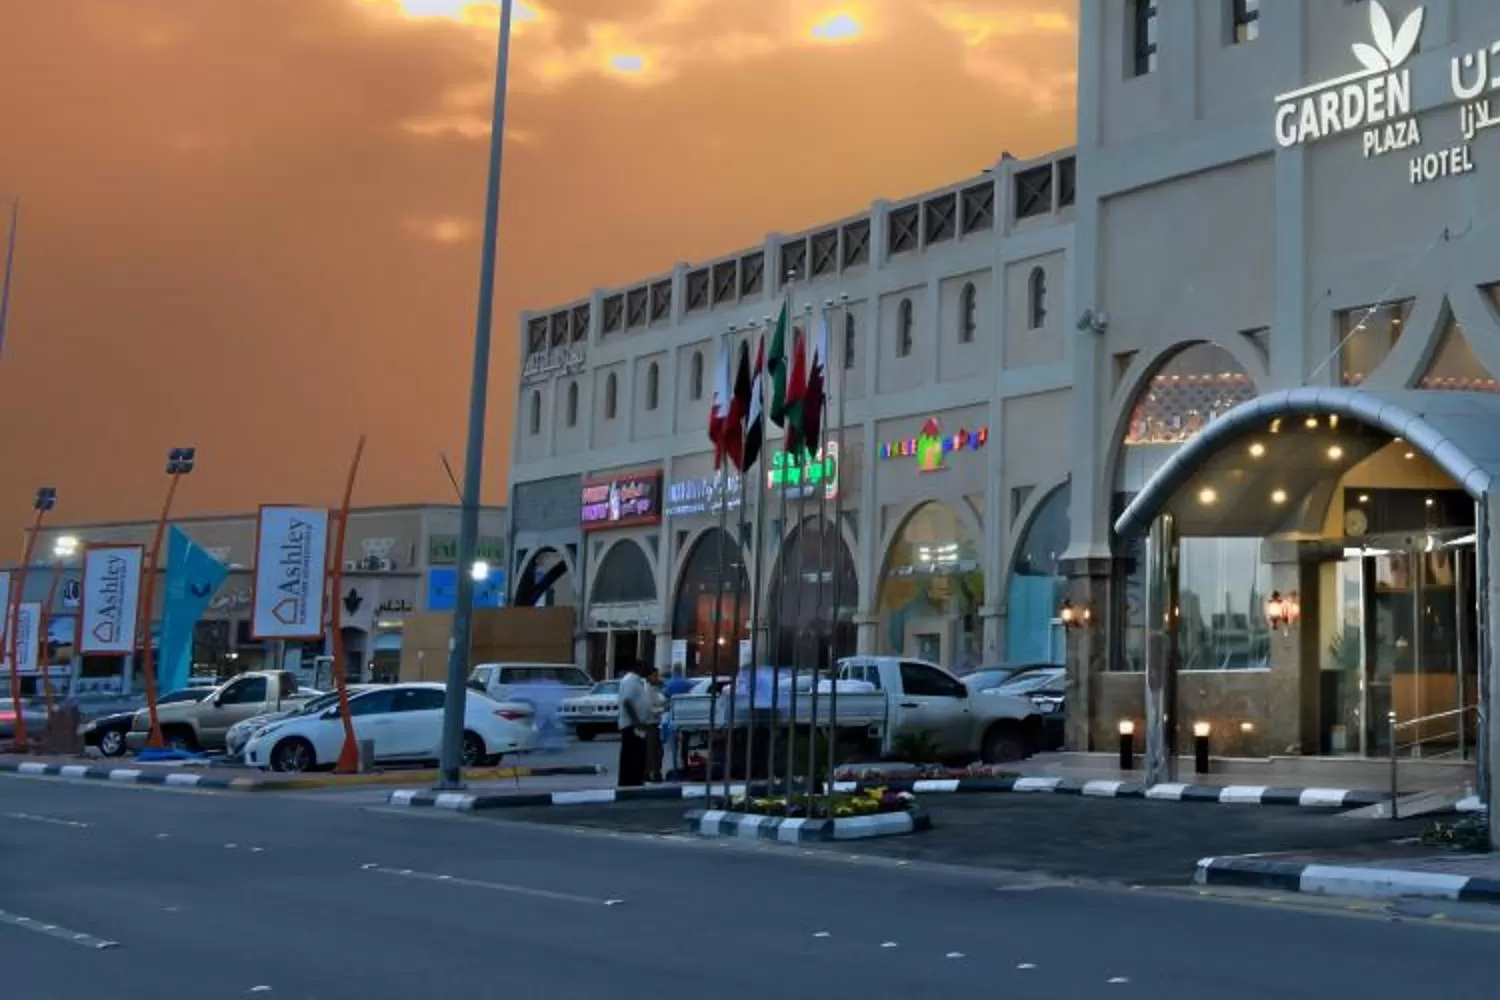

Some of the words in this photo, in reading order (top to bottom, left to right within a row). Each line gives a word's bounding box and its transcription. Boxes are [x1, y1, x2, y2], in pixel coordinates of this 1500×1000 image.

[1275, 69, 1411, 148] GARDEN
[1363, 118, 1421, 158] PLAZA
[1409, 146, 1474, 184] HOTEL
[98, 555, 124, 615] Ashley
[277, 519, 306, 595] Ashley
